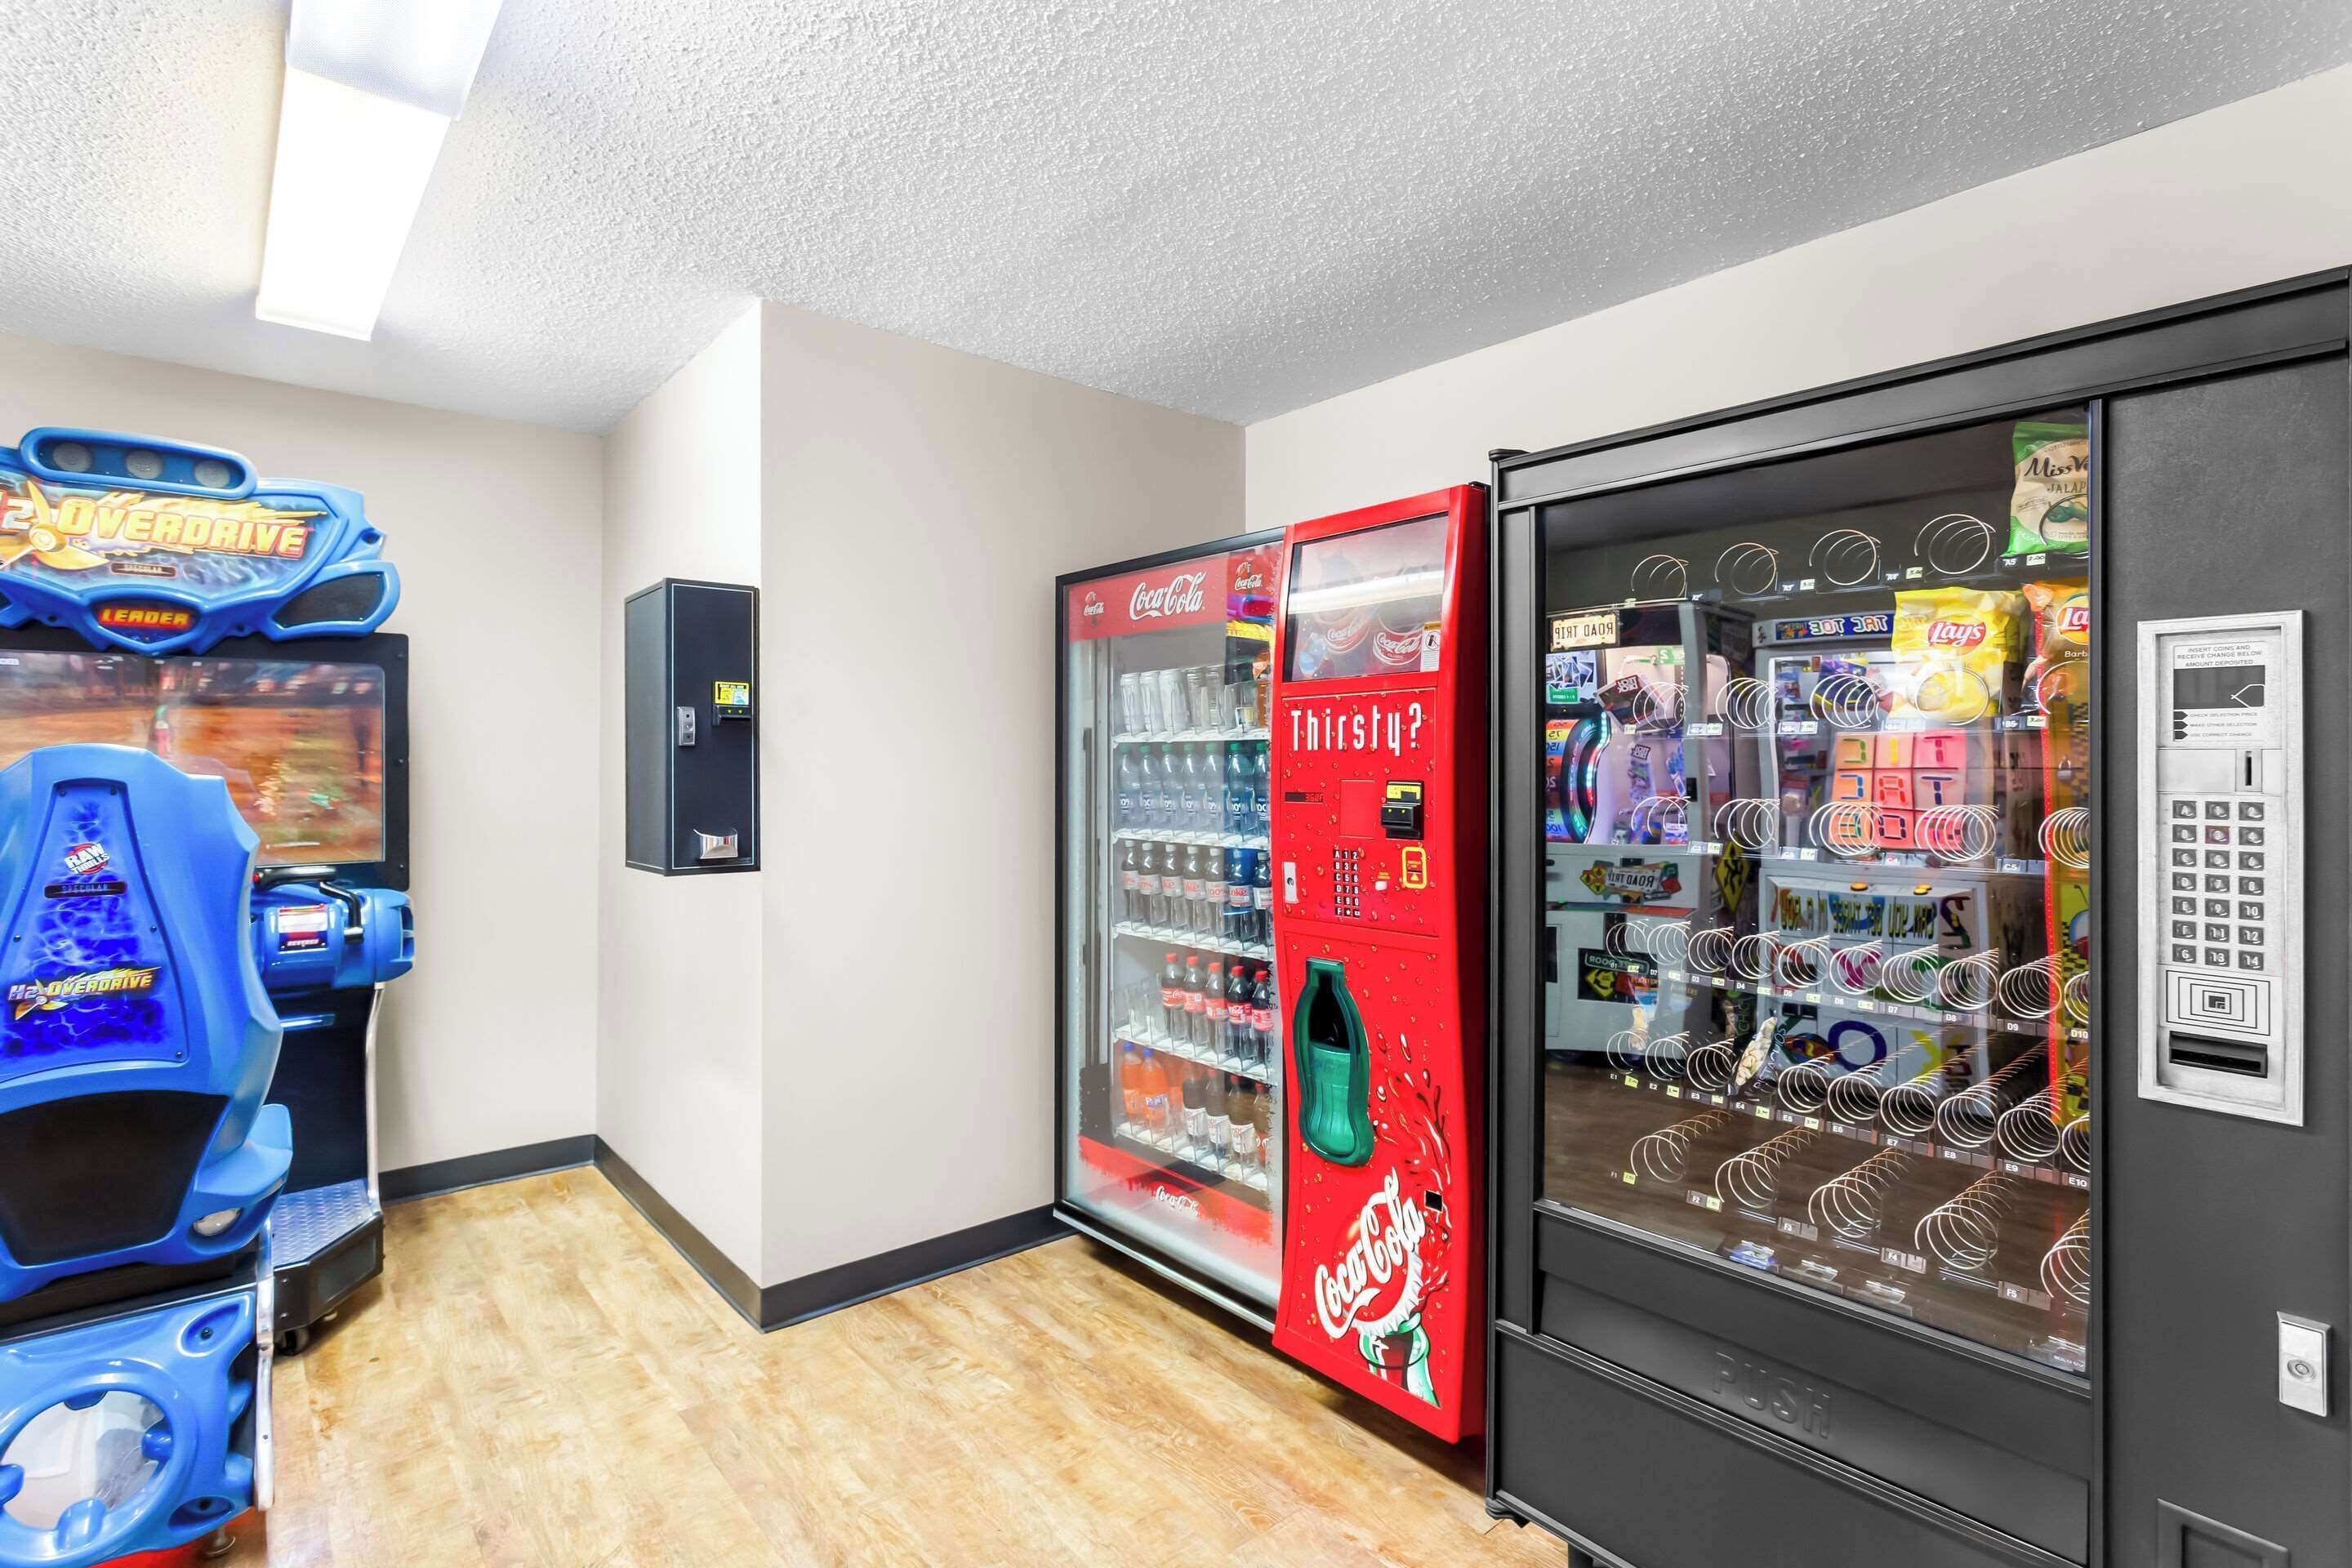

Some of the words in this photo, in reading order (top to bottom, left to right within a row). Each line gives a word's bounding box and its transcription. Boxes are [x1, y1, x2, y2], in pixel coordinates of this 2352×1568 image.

[2024, 457, 2072, 478] Miss
[0, 490, 35, 532] 2
[57, 496, 307, 559] OVERDRIVE
[1129, 572, 1207, 621] Coca-Cola
[101, 609, 189, 626] LEADER
[2060, 607, 2090, 631] La
[1290, 702, 1423, 757] Thirsty?
[65, 843, 105, 868] RAW
[47, 974, 154, 996] OVERDRIVE
[1887, 1005, 1899, 1013] D7
[1946, 1013, 1957, 1022] D8
[2007, 1022, 2019, 1031] D9
[2071, 1028, 2089, 1039] D10
[1691, 1091, 1700, 1100] E3
[1735, 1102, 1745, 1110] E4
[1887, 1137, 1899, 1146] E7
[1944, 1150, 1956, 1159] E8
[2006, 1162, 2019, 1172] E9
[2069, 1176, 2087, 1187] E10
[1691, 1195, 1700, 1204] F2
[1315, 1166, 1426, 1339] Coca-Cola
[2007, 1287, 2017, 1298] F5
[1713, 1351, 1832, 1440] PUSH
